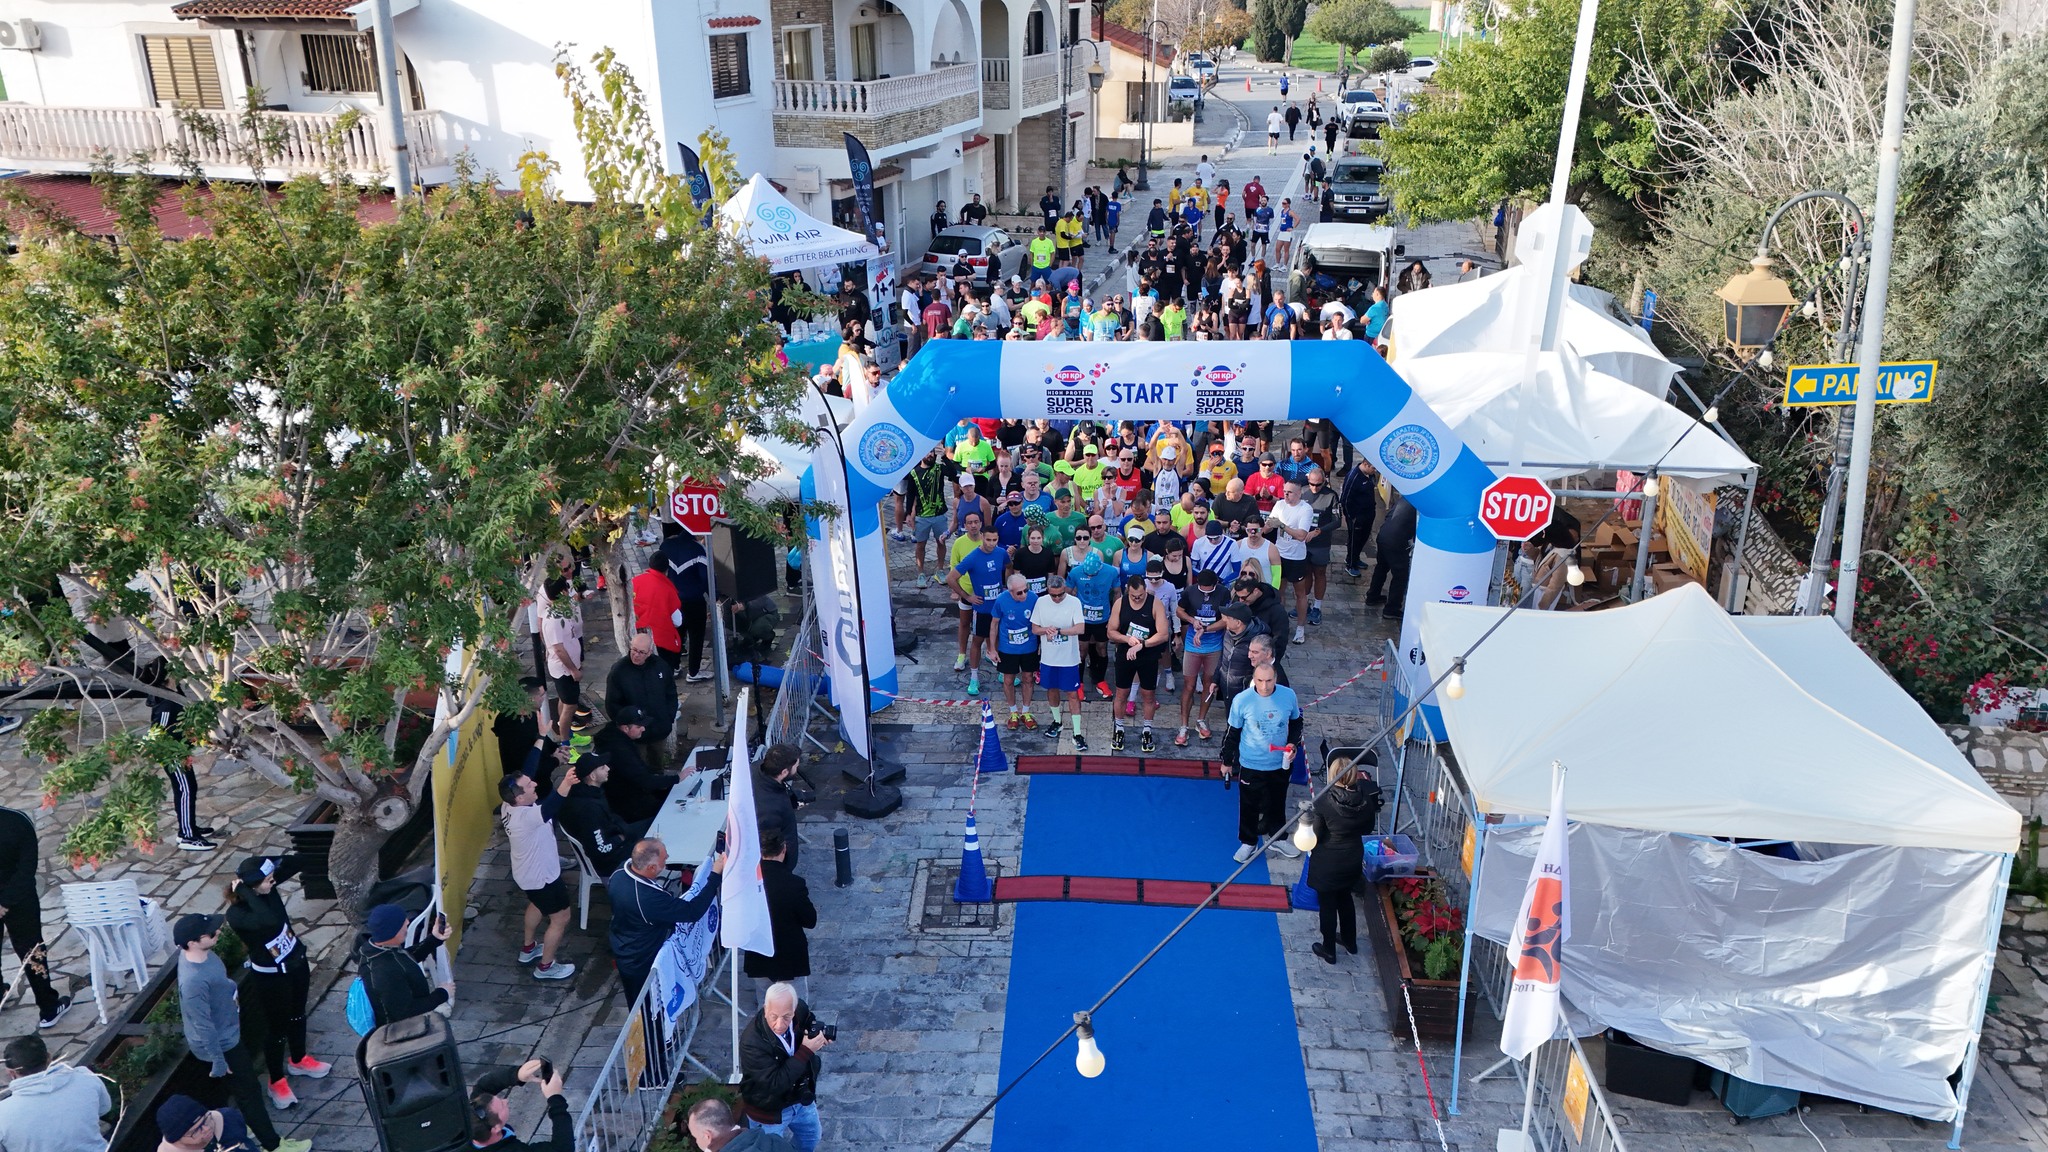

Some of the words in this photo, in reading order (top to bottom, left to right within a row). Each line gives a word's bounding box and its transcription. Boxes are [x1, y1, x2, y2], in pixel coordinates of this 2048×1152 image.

[758, 232, 789, 245] WIN
[795, 229, 822, 241] AIR
[783, 253, 817, 265] BETTER
[818, 245, 868, 260] BREATHING
[871, 278, 896, 303] 1+1
[1110, 383, 1178, 404] START
[1047, 397, 1093, 407] SUPER
[1047, 406, 1094, 414] SPOON
[1196, 397, 1244, 407] SUPER
[1196, 406, 1244, 414] SPOON
[1485, 491, 1549, 523] STOP
